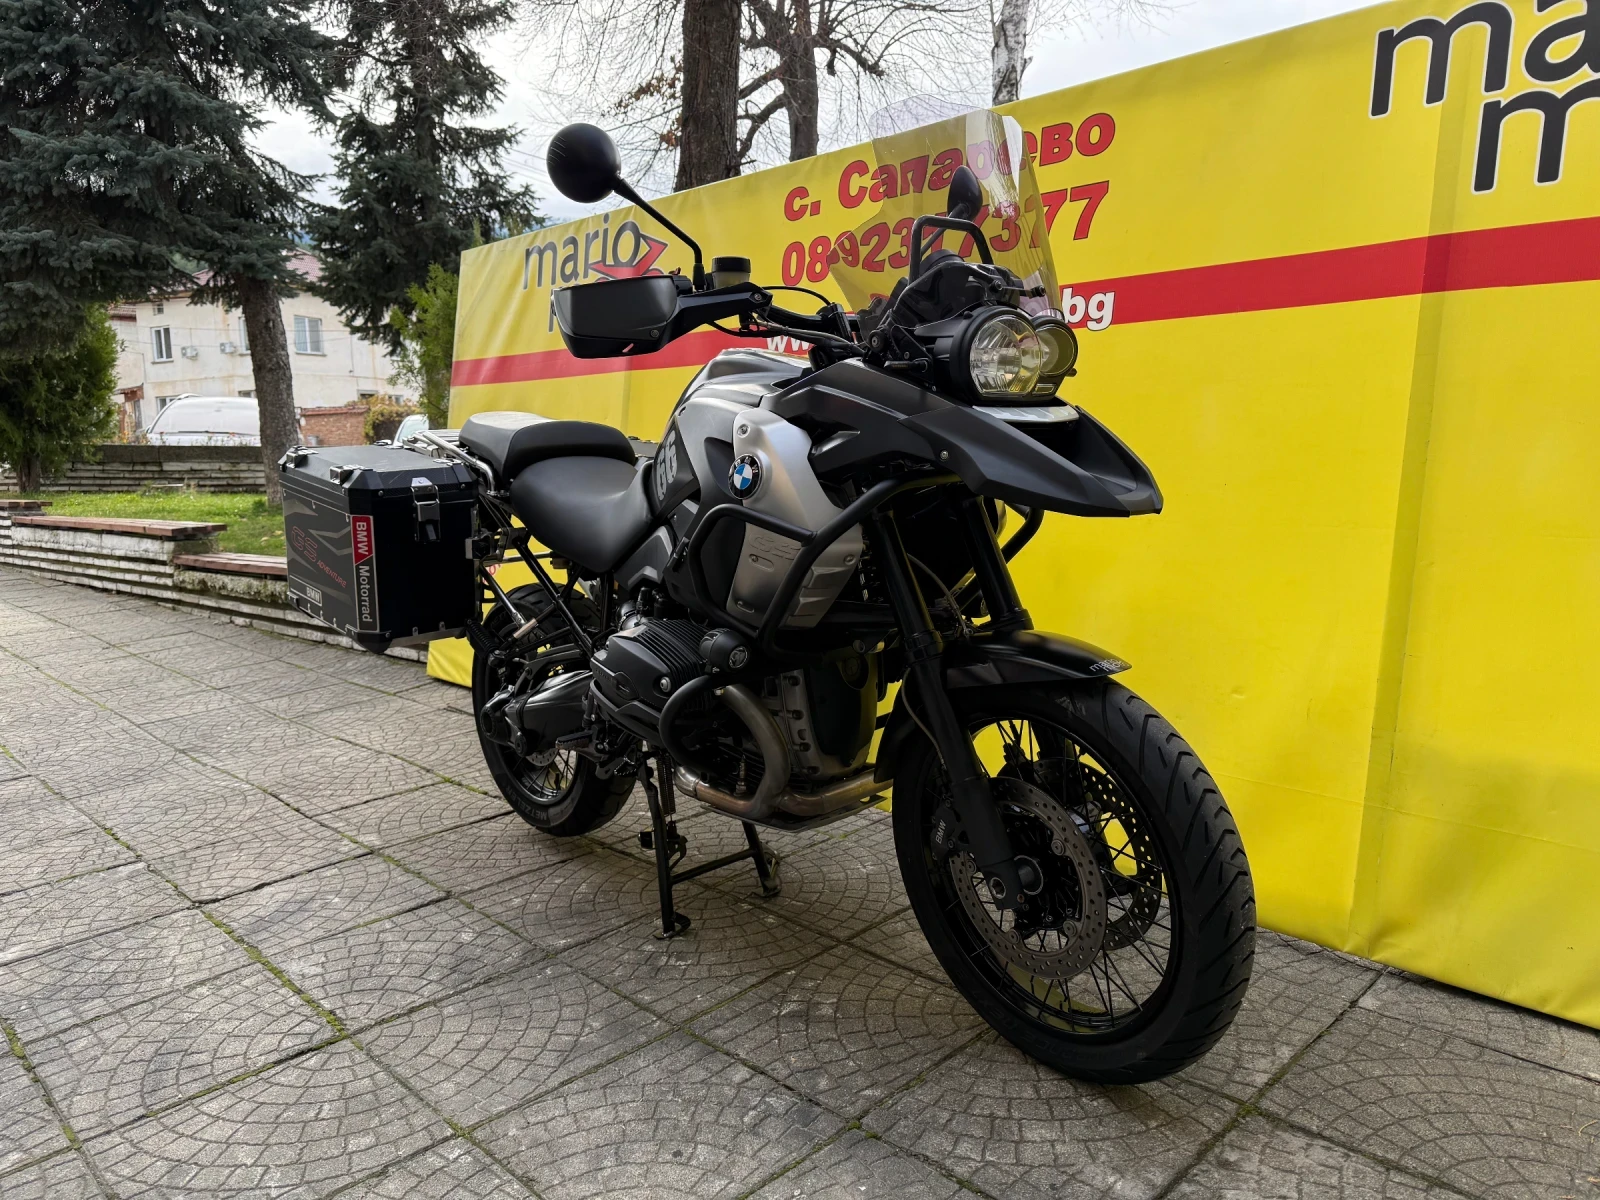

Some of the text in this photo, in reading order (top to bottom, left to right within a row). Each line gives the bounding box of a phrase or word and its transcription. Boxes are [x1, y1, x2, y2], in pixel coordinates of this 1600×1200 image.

[784, 186, 821, 221] с.
[523, 213, 641, 290] mario
[317, 560, 347, 588] ADVENTURE
[356, 522, 373, 622] BMW Motorrad
[306, 587, 320, 602] BMW
[505, 785, 548, 821] METZELER
[935, 819, 947, 844] BMW
